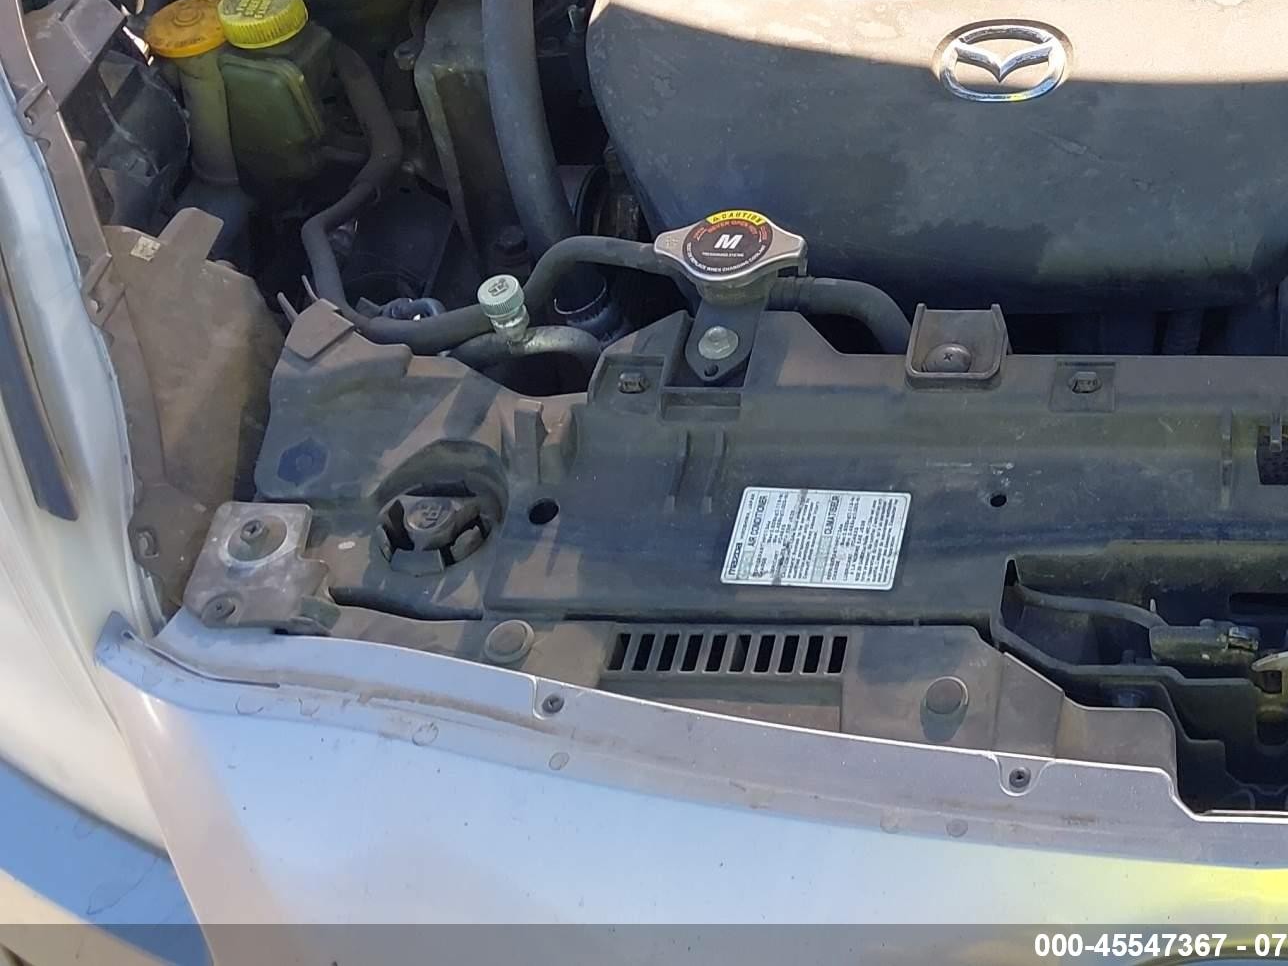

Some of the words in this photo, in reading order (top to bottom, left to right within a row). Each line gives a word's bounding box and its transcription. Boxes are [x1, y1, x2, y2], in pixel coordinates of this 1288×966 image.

[722, 212, 761, 223] CAUTION
[714, 234, 743, 249] M
[750, 495, 768, 535] CONDITIONER
[823, 495, 840, 535] CLIMATISEUR
[747, 536, 757, 547] AIR
[728, 543, 742, 575] mazda
